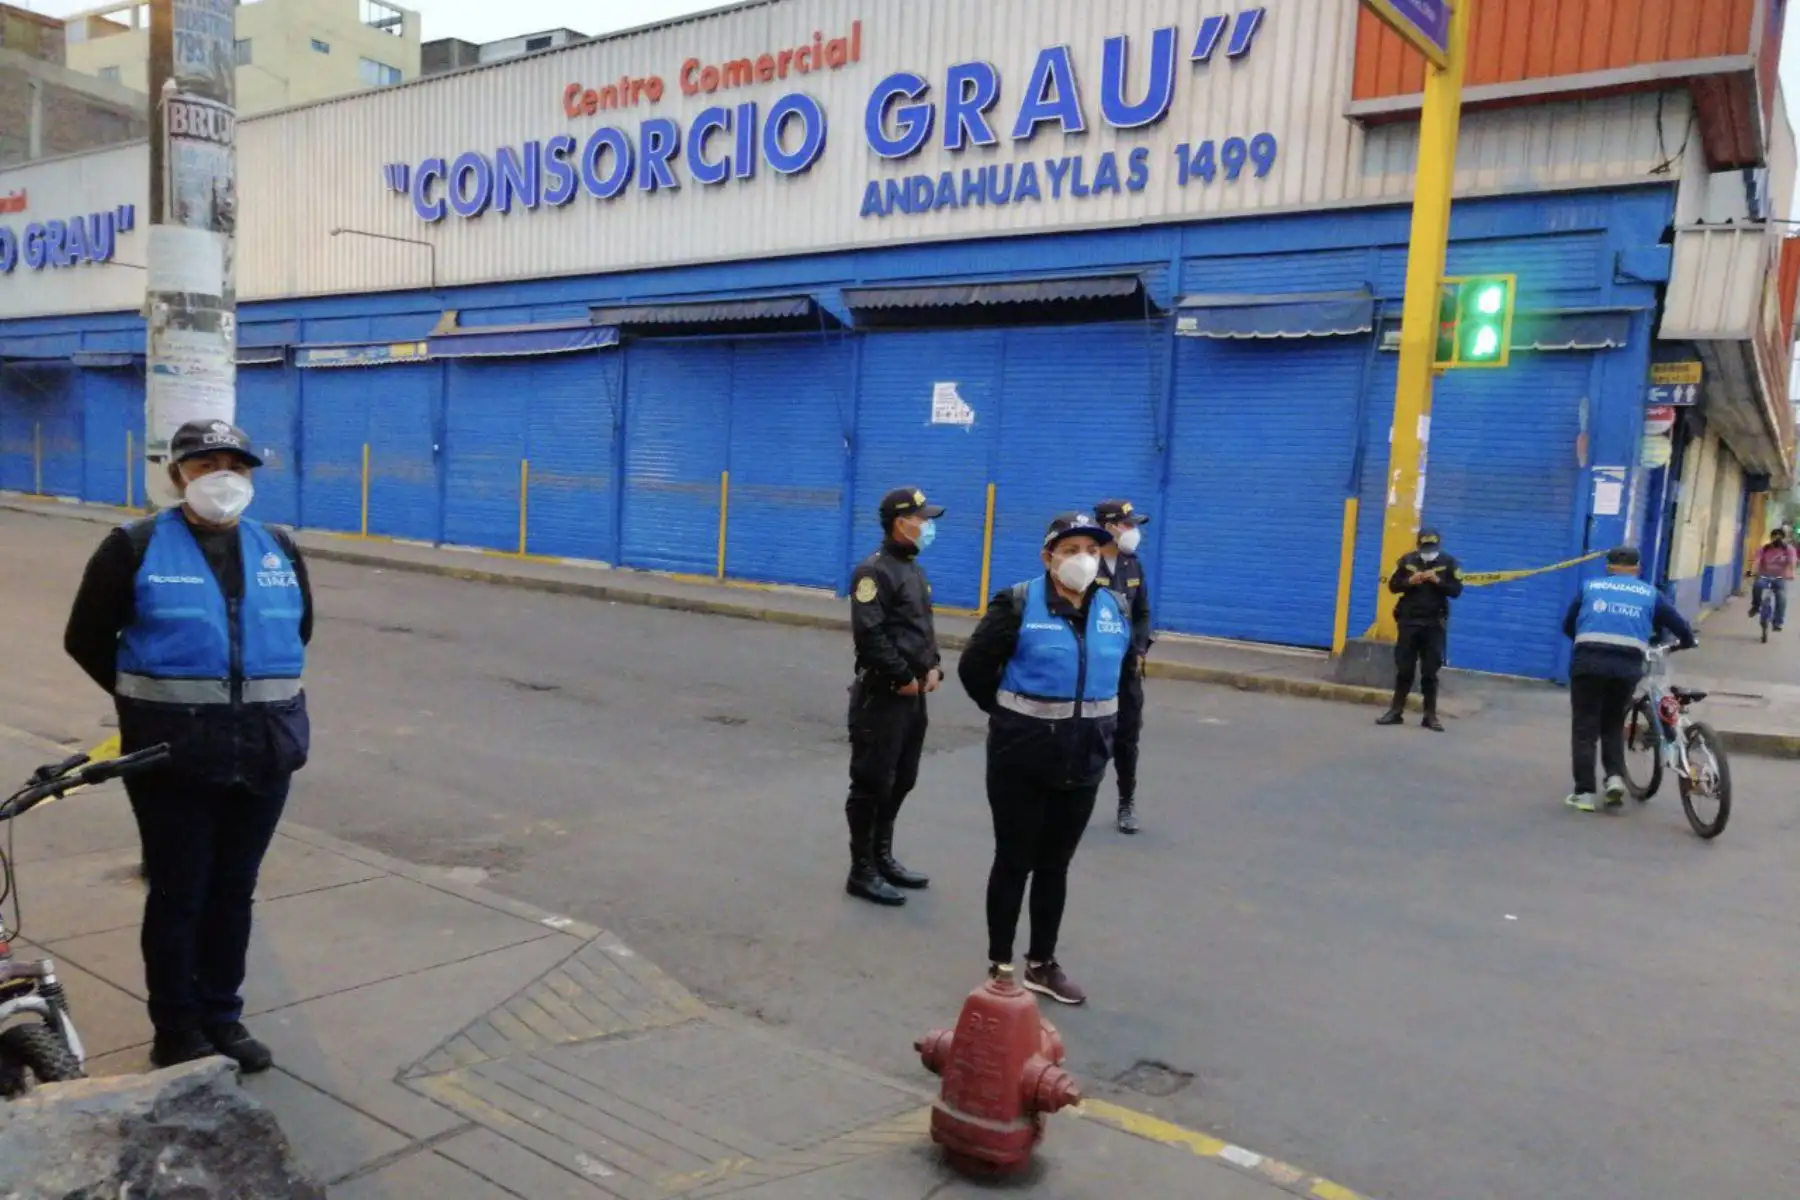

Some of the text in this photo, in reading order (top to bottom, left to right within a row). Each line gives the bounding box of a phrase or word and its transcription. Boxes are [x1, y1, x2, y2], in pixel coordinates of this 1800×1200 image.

[563, 20, 862, 119] Centro Comercial
[168, 102, 235, 144] BRUJ
[383, 93, 827, 222] "CONSORCIO
[860, 132, 1278, 218] ANDAHUAYLAS 1499
